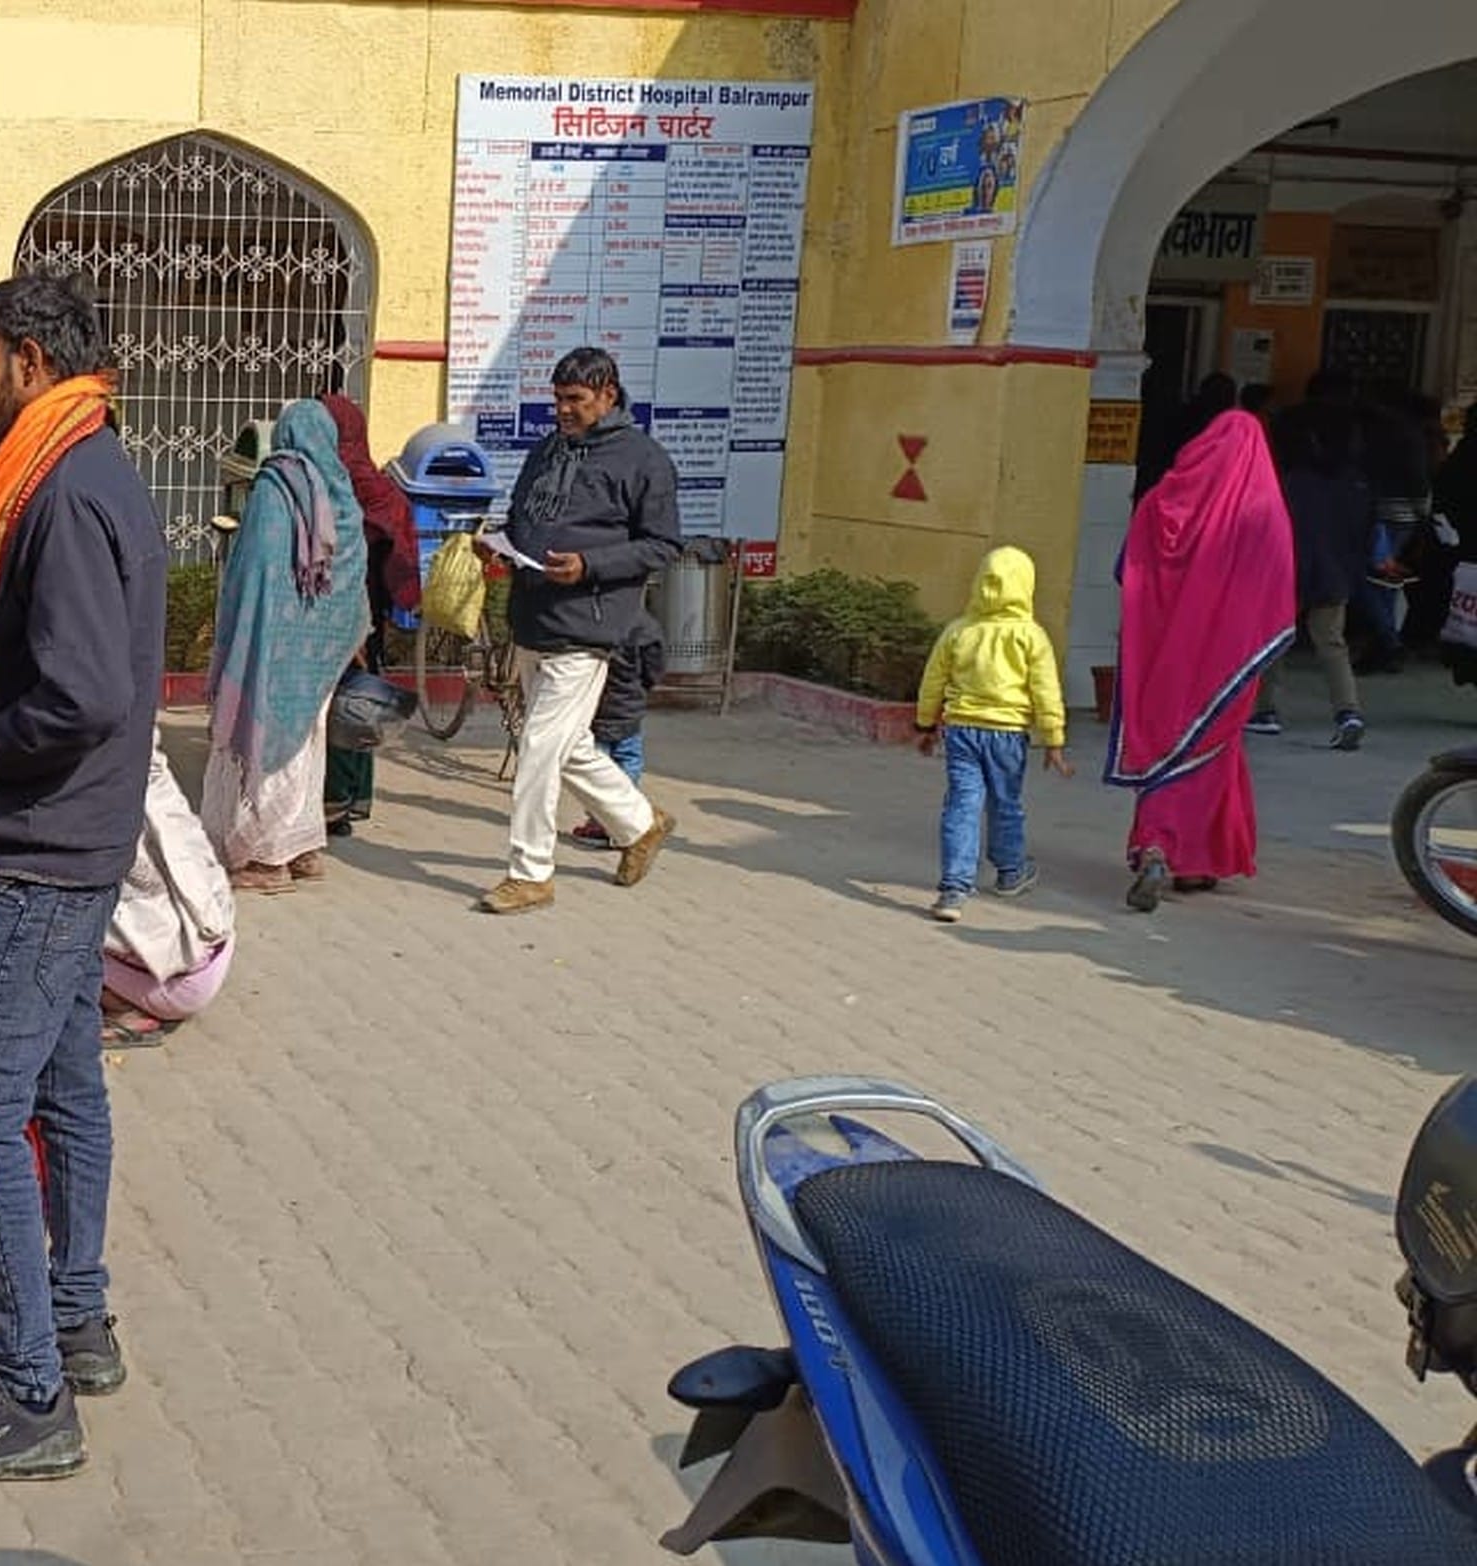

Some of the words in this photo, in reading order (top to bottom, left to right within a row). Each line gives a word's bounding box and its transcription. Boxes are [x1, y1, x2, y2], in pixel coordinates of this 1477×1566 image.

[480, 81, 562, 101] Memorial
[569, 83, 635, 103] District
[640, 84, 713, 109] Hospital
[719, 86, 811, 111] Balrampur
[552, 106, 649, 138] सिटिजन
[657, 107, 716, 139] चार्टर
